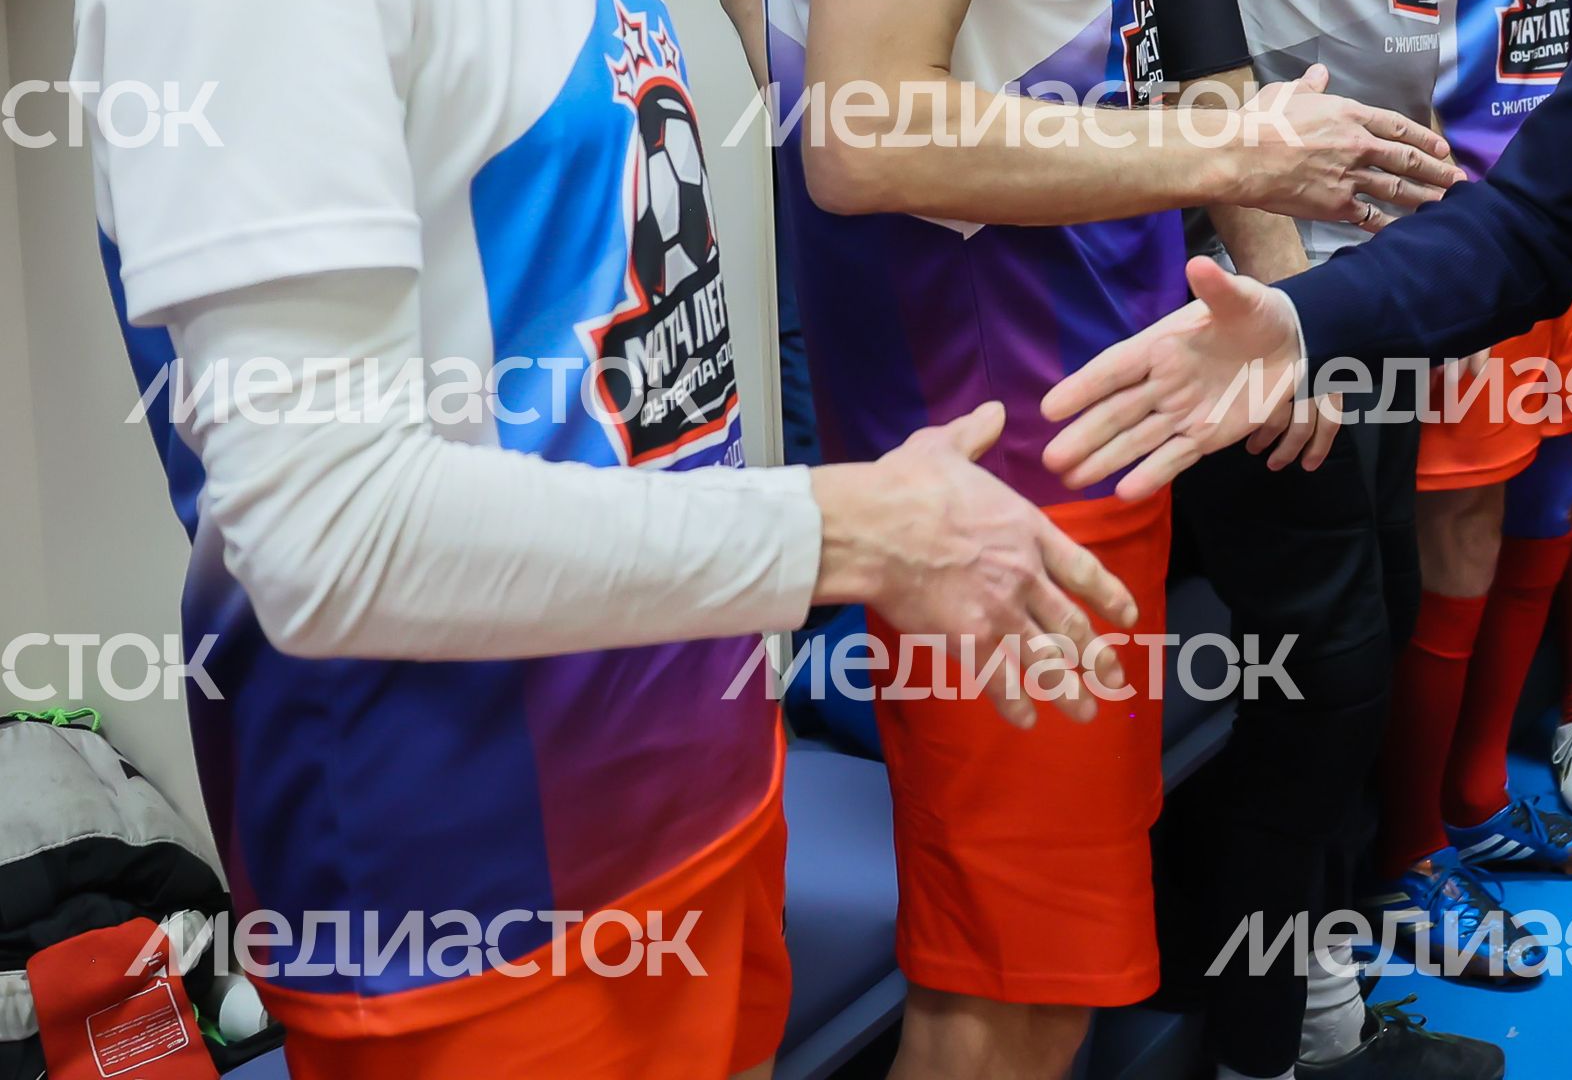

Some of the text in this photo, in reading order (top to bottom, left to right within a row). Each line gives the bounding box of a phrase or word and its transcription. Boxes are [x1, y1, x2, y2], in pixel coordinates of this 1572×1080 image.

[1491, 102, 1501, 117] С
[624, 274, 727, 397] МАТЧ ЛЕГ
